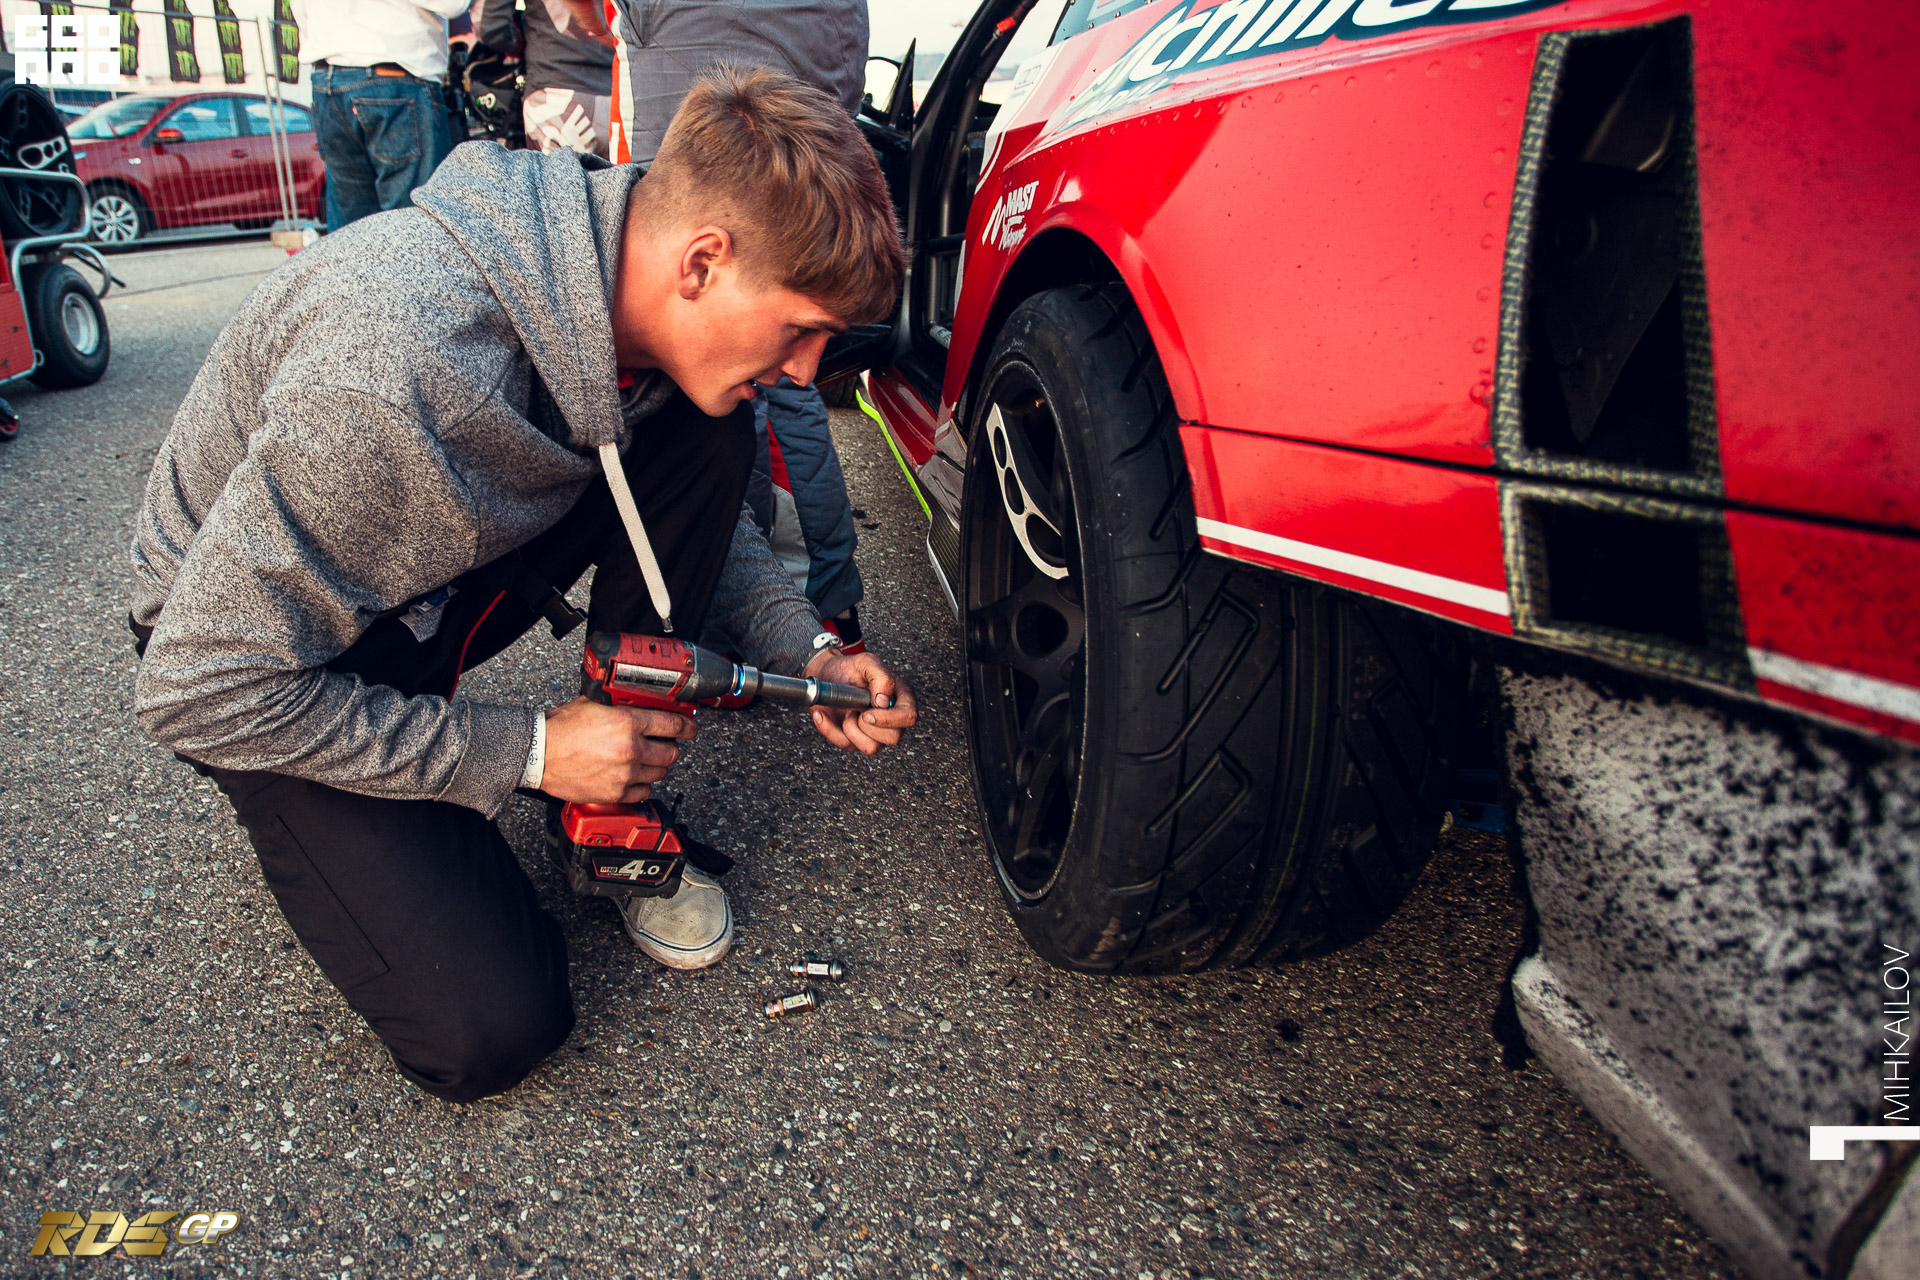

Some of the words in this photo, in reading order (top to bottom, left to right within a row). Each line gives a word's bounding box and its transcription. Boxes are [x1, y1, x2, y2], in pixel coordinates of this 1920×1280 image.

[1060, 0, 1536, 113] Achi
[1004, 180, 1040, 218] MAST
[618, 860, 660, 880] 4.0
